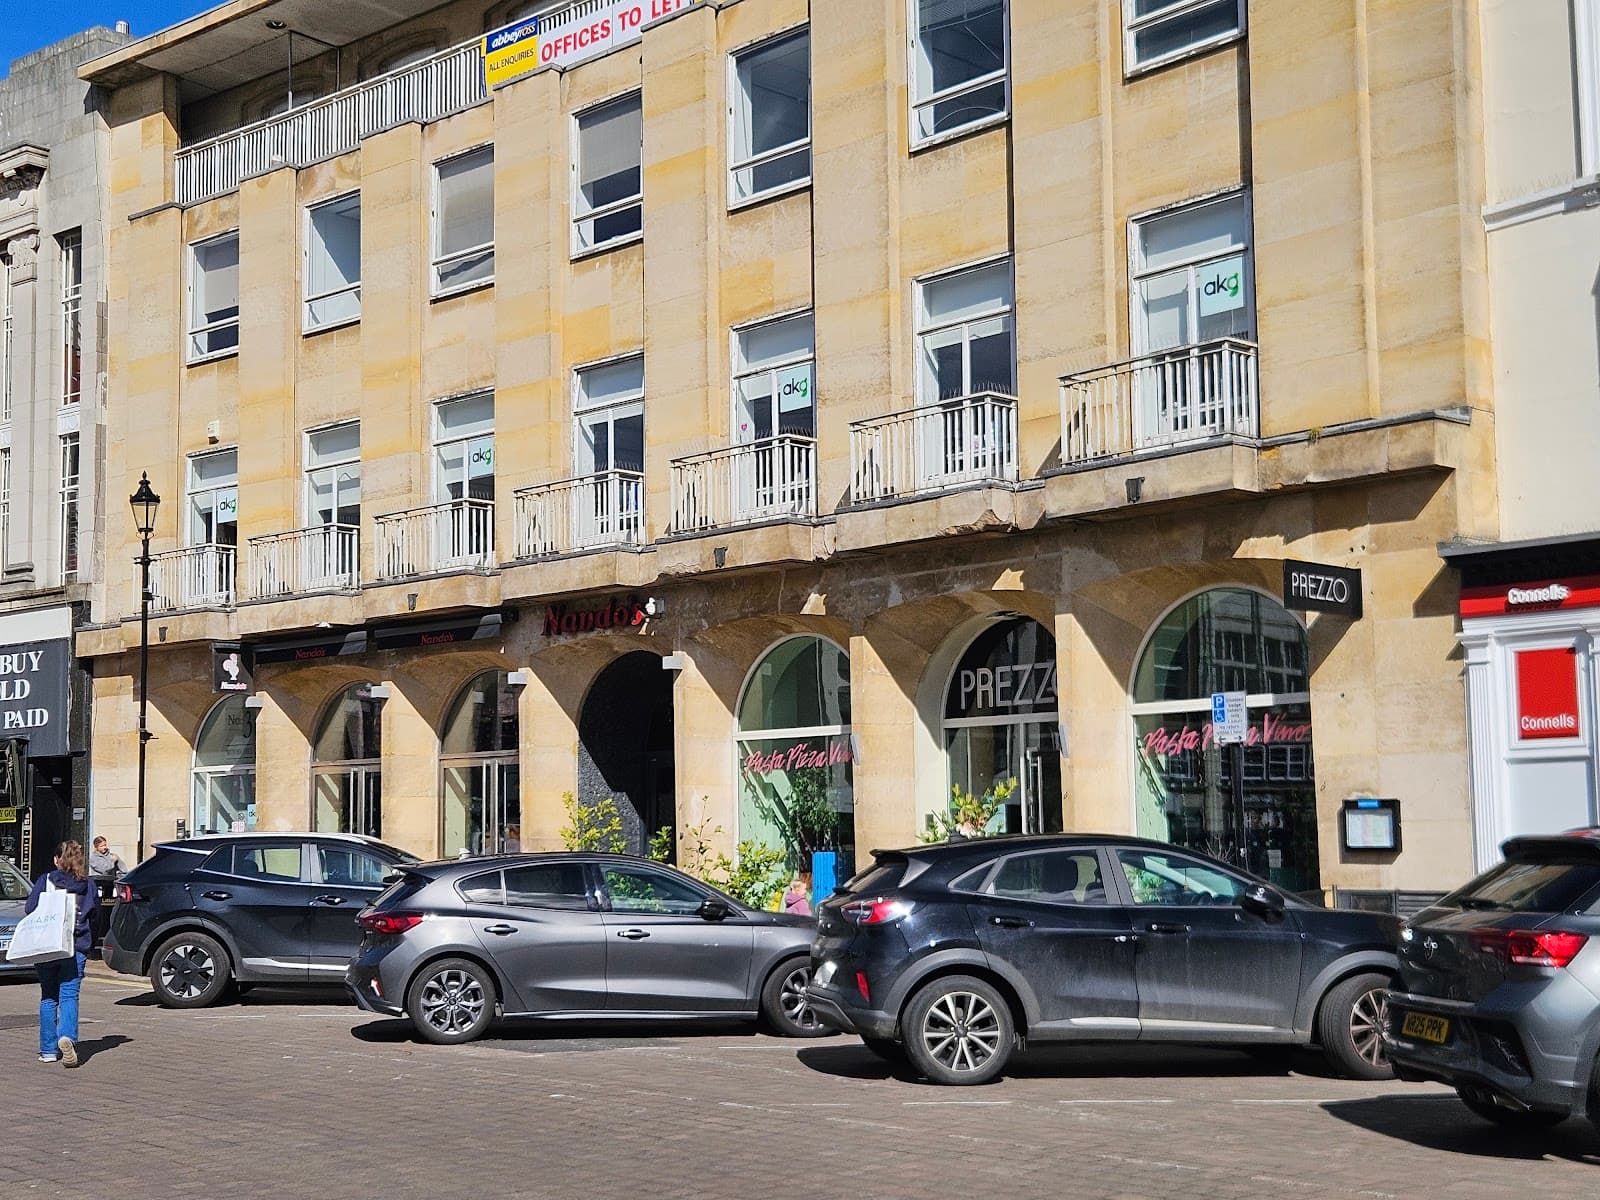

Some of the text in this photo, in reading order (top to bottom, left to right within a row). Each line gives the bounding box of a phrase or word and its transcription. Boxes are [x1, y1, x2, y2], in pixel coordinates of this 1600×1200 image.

[492, 24, 536, 48] abbeyross
[541, 19, 610, 62] OFFICES
[618, 7, 641, 31] TO
[489, 48, 534, 72] ALL ENQUIRIES
[1204, 273, 1238, 297] akg
[783, 378, 807, 397] akg
[472, 448, 491, 465] akg
[219, 497, 236, 513] akg
[1291, 572, 1349, 604] PREZZO
[1508, 584, 1570, 604] Connells
[0, 651, 44, 675] BUY
[0, 679, 30, 701] LD
[4, 708, 49, 729] PAID
[1521, 714, 1575, 730] Connells
[1144, 726, 1200, 758] Pasta
[745, 750, 785, 777] Pasta
[786, 743, 827, 771] Pizza
